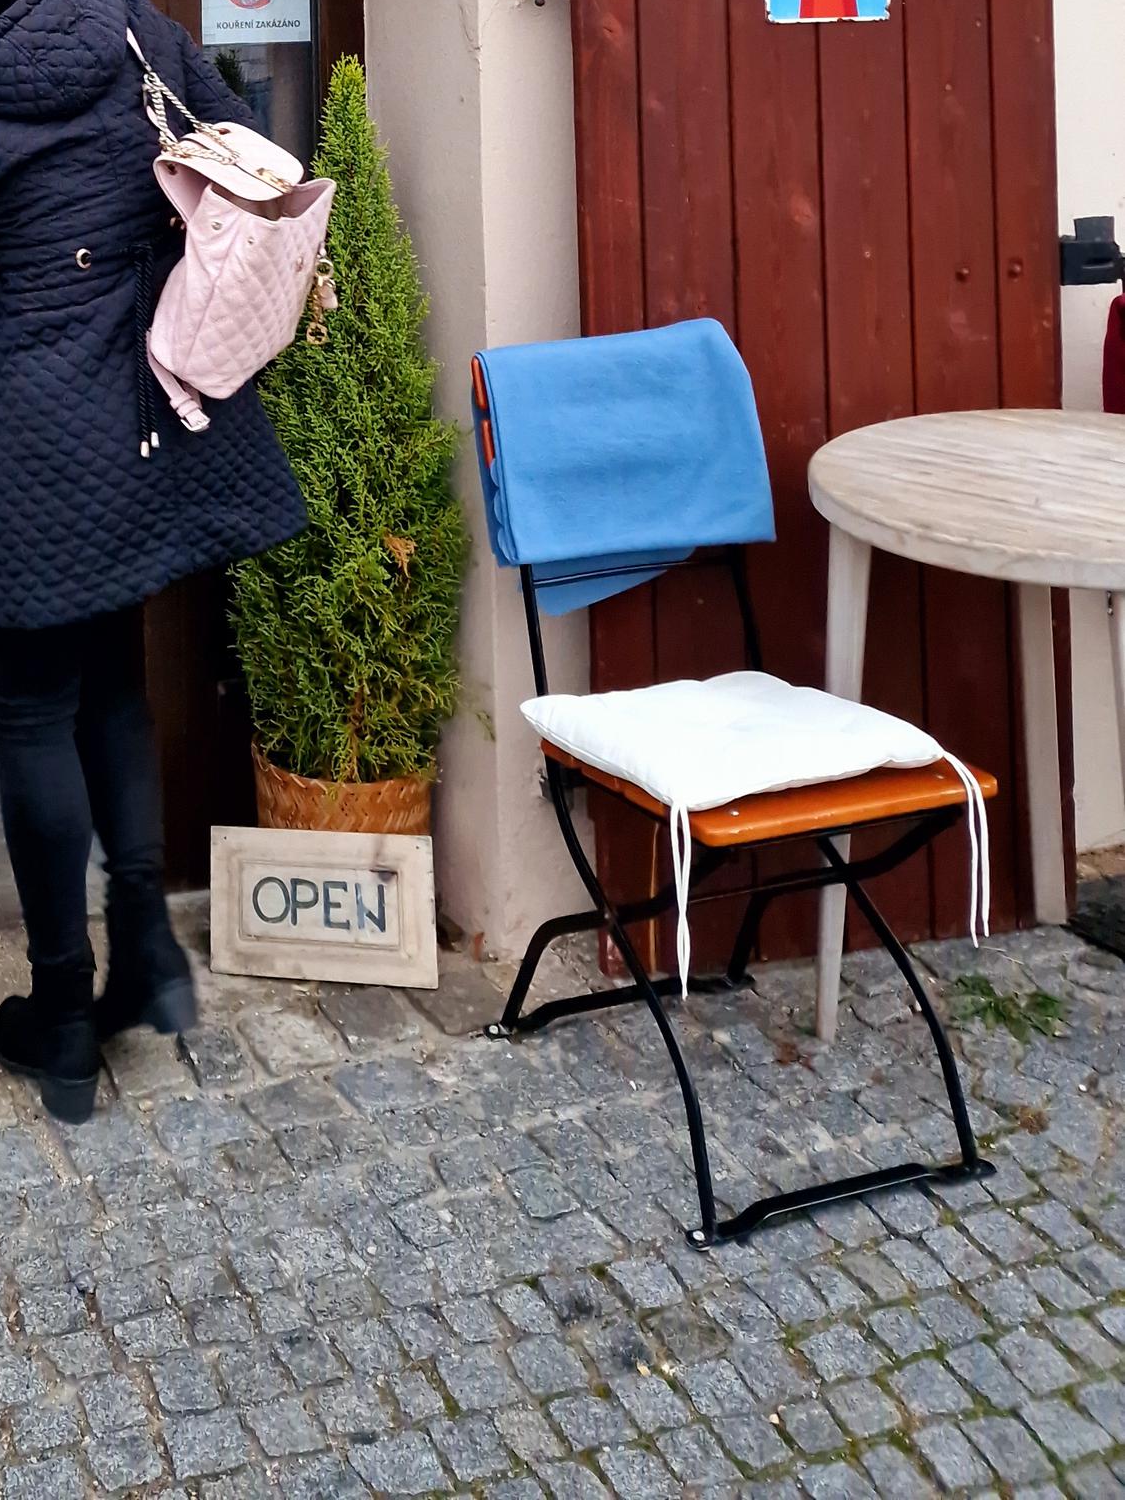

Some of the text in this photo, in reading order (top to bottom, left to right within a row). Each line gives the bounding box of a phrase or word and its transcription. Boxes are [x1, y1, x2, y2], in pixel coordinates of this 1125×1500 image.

[216, 18, 301, 30] KOUŘENÍ ZAKÁZÁNO
[252, 876, 386, 933] OPEN
